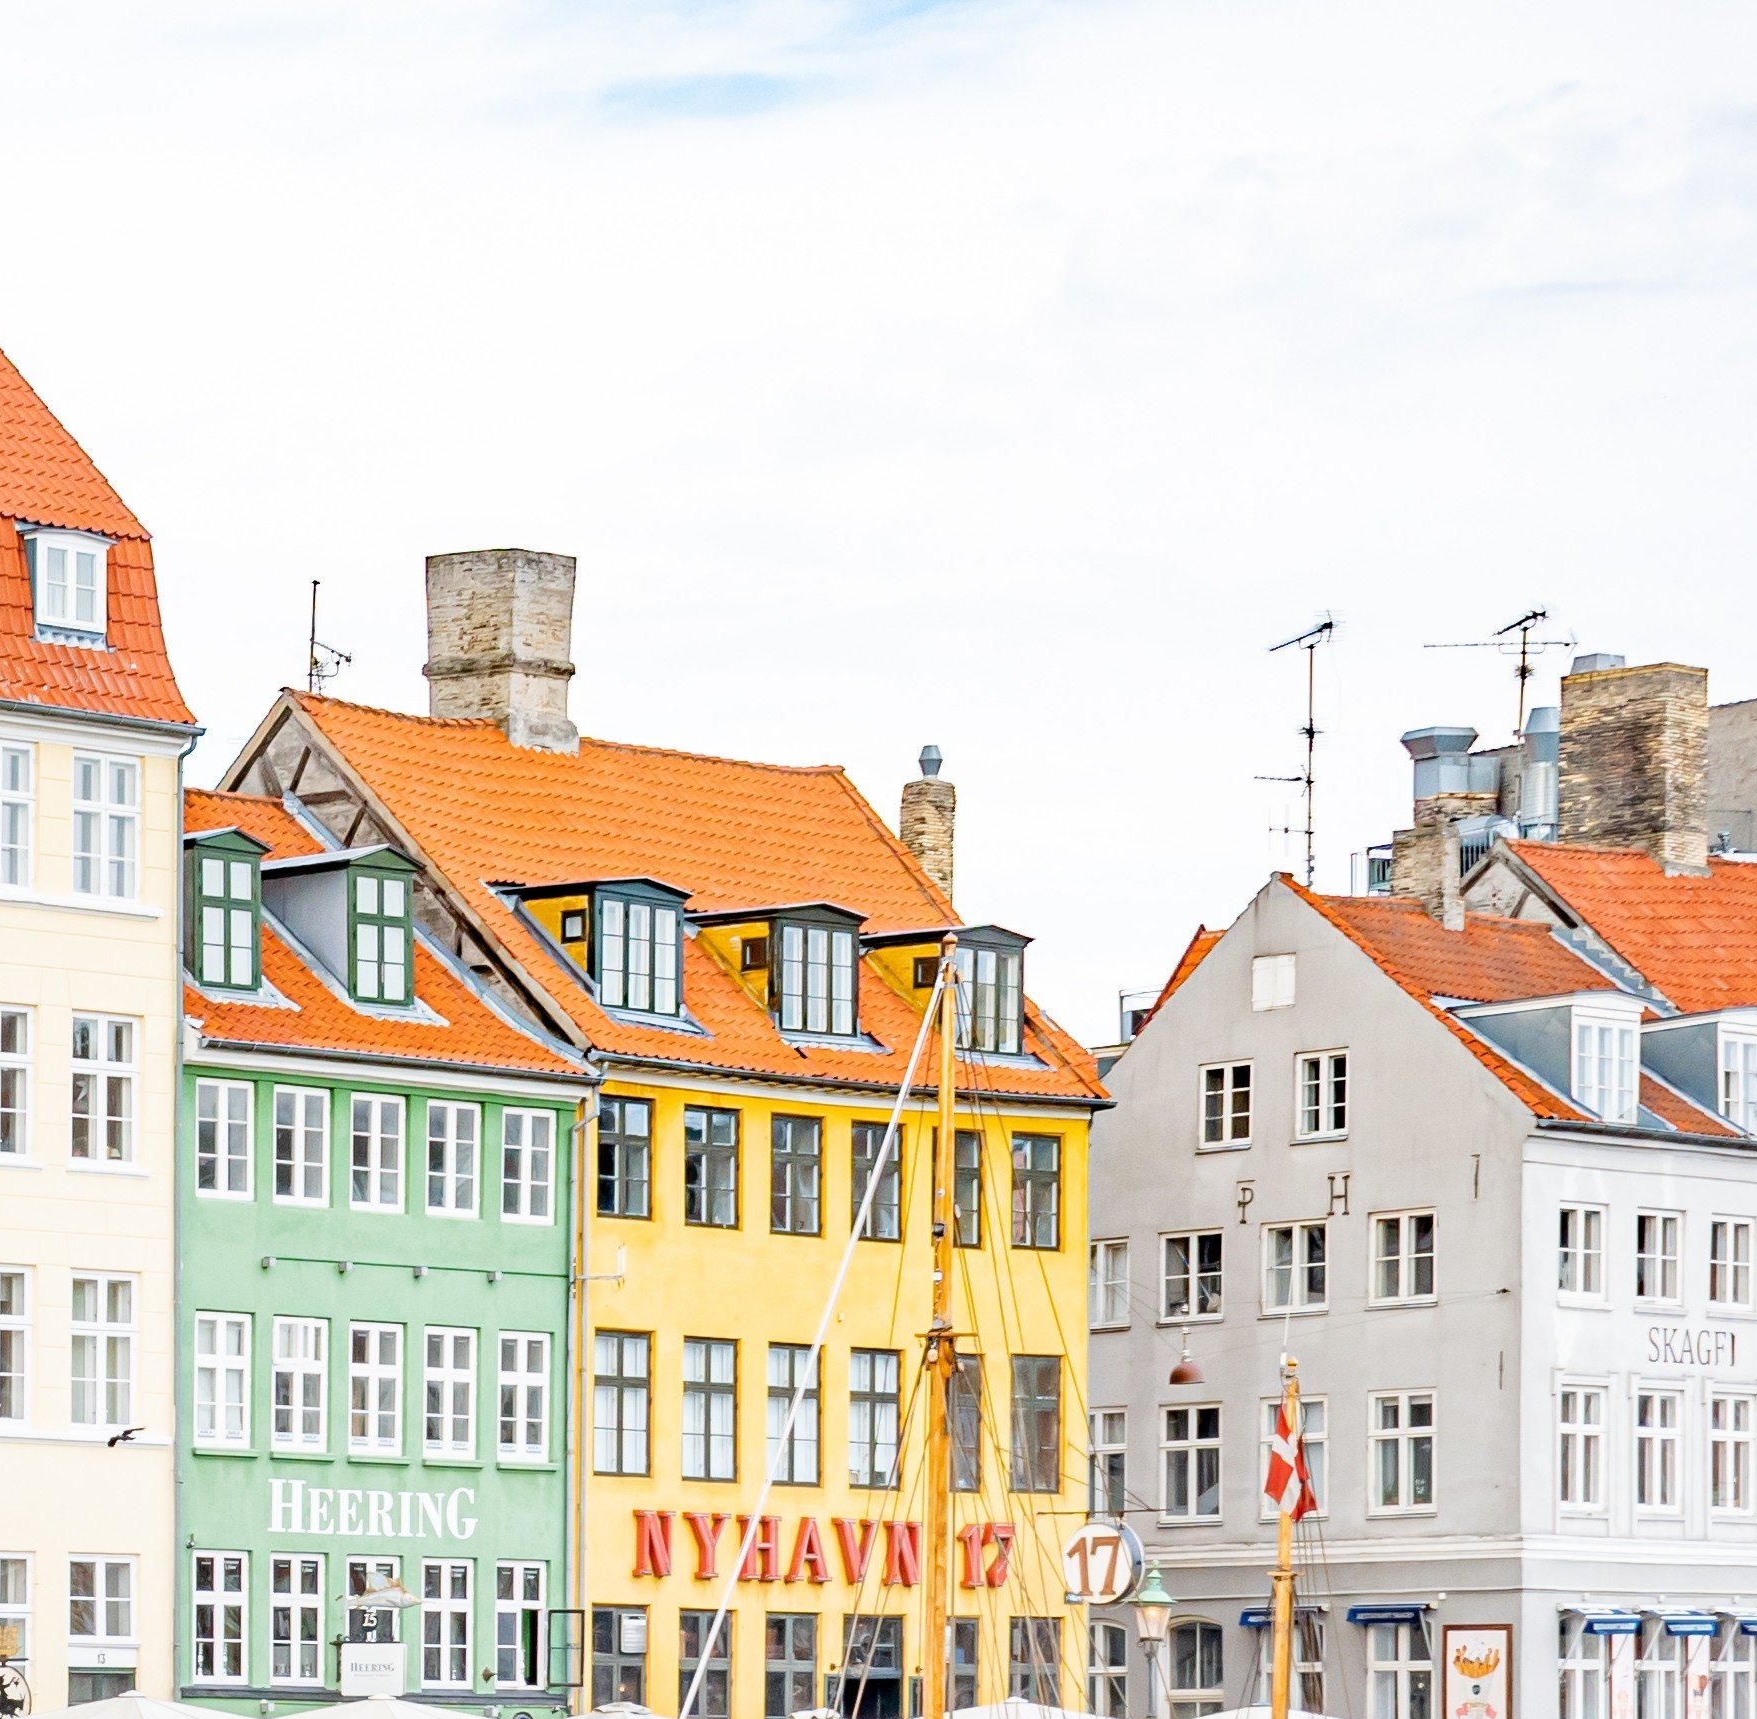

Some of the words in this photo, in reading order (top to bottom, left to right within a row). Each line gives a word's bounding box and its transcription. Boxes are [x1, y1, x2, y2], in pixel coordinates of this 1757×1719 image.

[267, 1478, 478, 1540] HEERING
[632, 1509, 923, 1587] NYHAVN
[957, 1523, 1016, 1589] 17
[1067, 1535, 1121, 1596] 17
[362, 1612, 377, 1627] 15
[350, 1662, 395, 1672] HEERING
